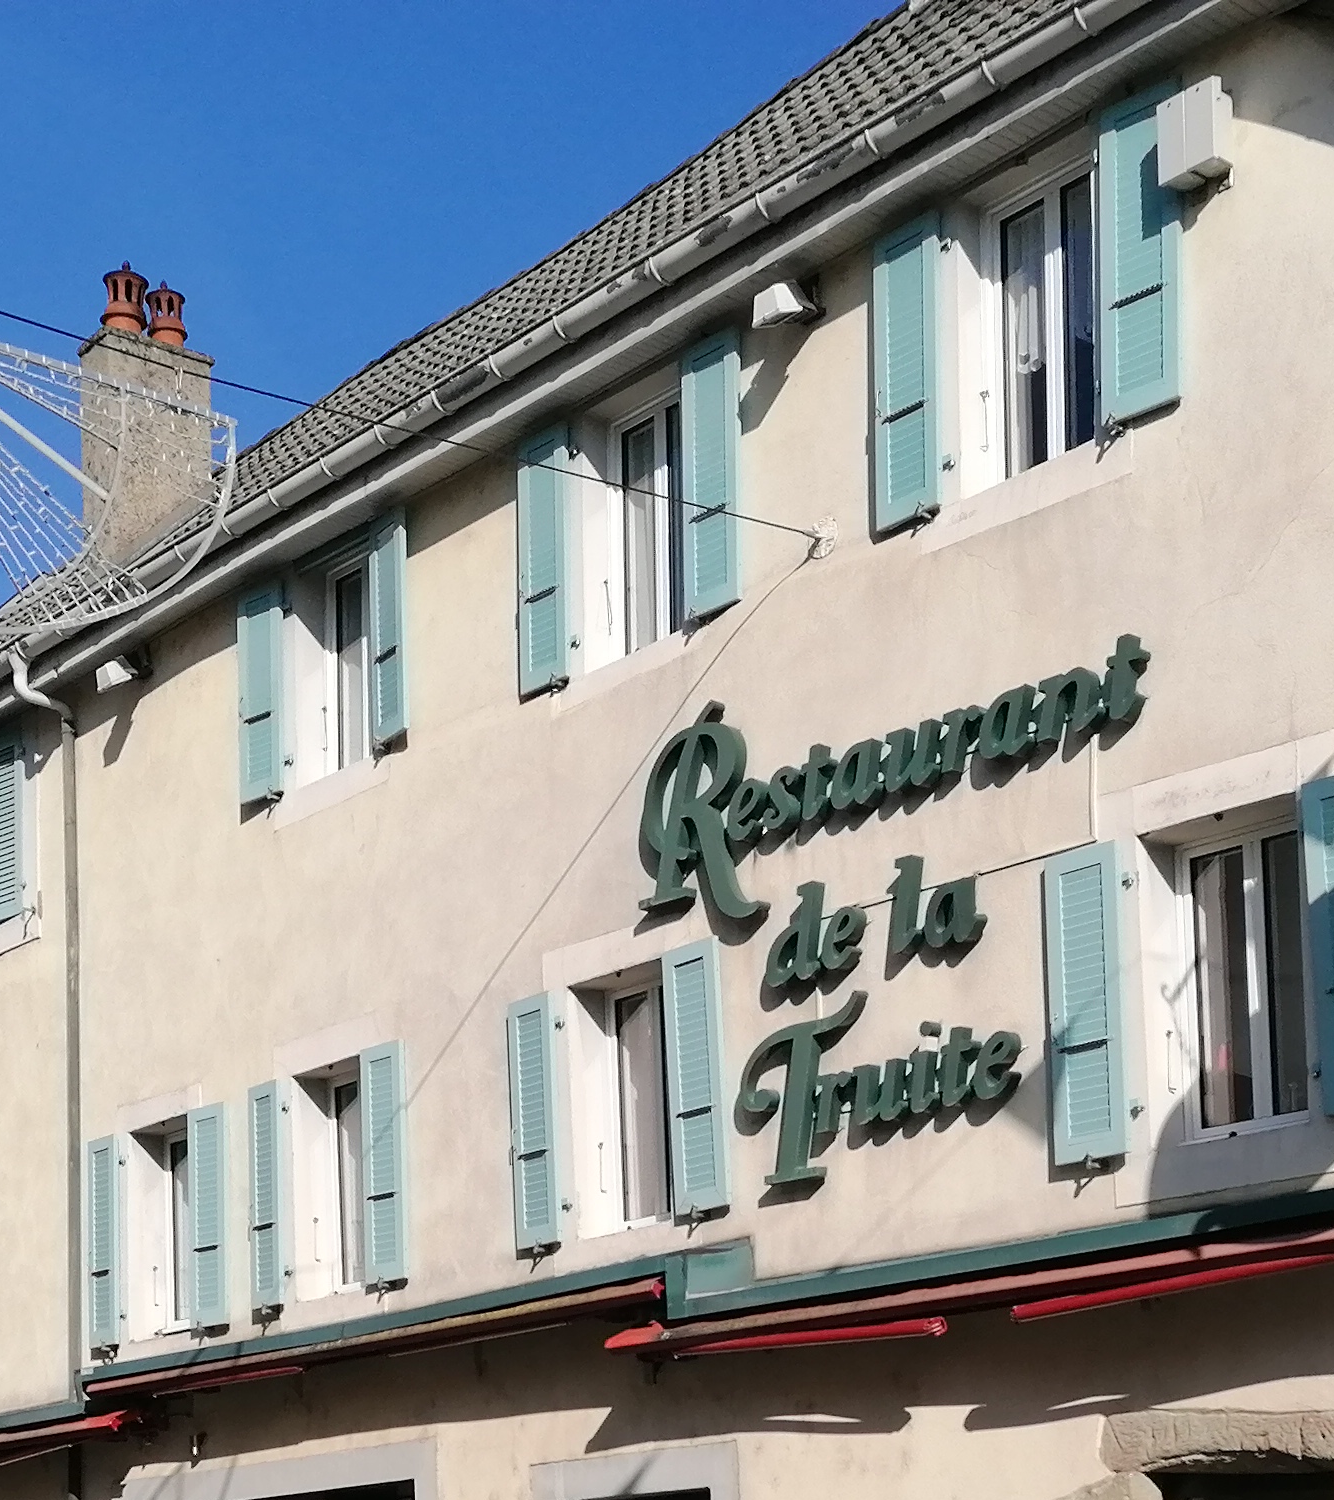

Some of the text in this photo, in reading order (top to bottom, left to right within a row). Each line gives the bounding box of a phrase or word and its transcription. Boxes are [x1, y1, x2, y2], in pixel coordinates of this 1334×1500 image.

[638, 634, 1151, 920] Restaurant
[765, 854, 988, 988] de la
[734, 990, 1022, 1186] Truite
